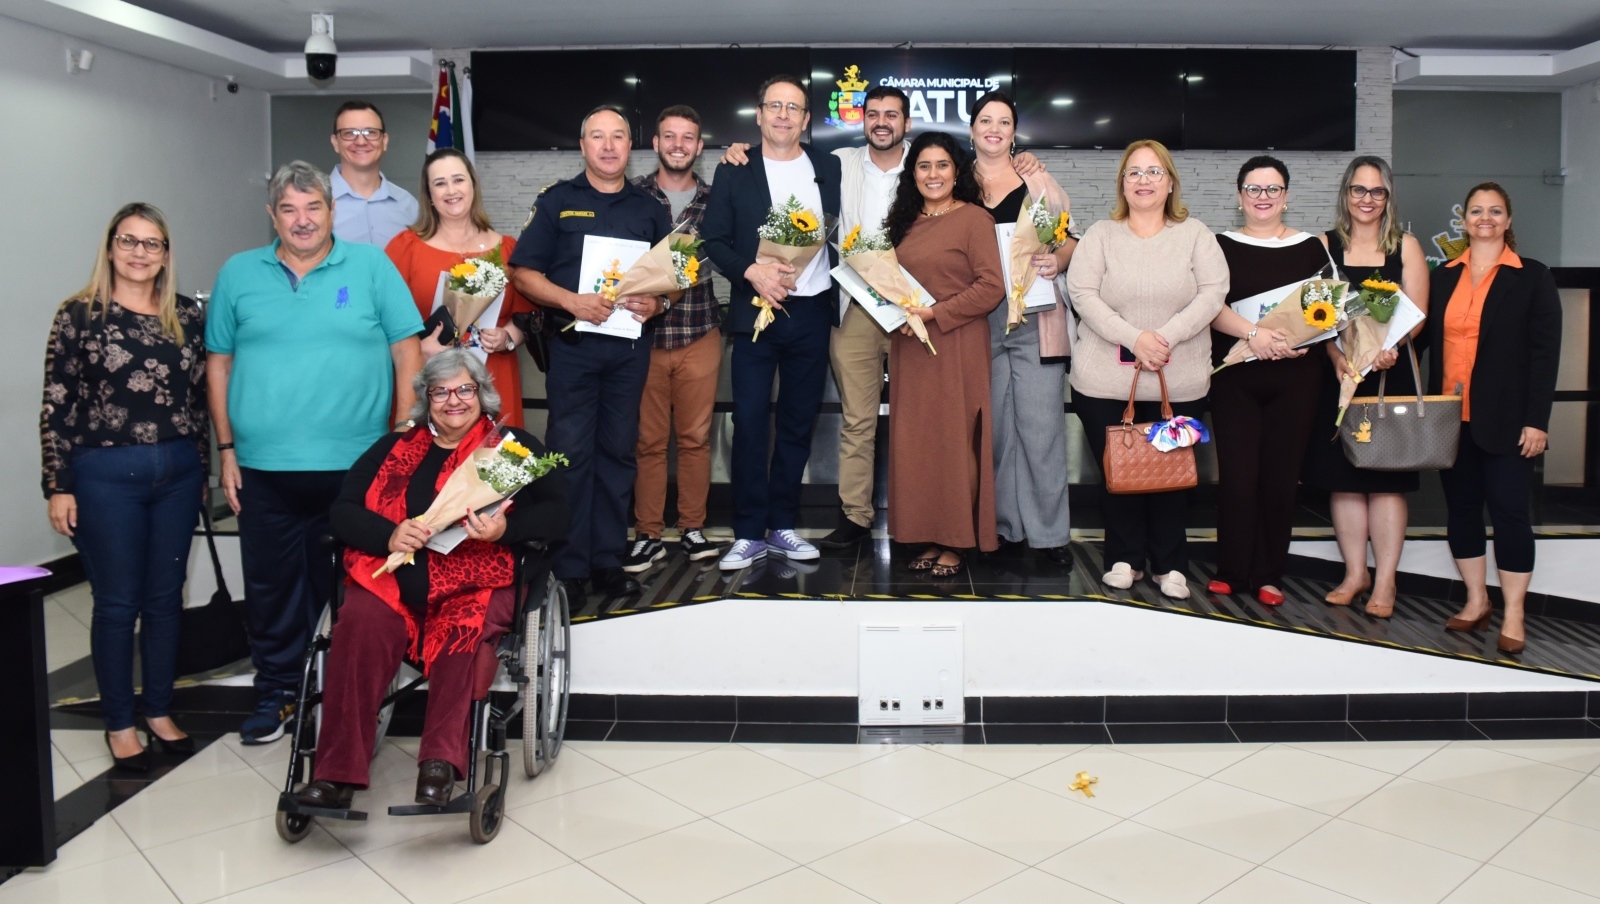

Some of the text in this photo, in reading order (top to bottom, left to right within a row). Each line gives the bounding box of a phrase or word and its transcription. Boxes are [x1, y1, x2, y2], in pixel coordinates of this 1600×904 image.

[880, 76, 1000, 88] CÂMARA MUNICIPAL DE
[902, 86, 1000, 124] ATU
